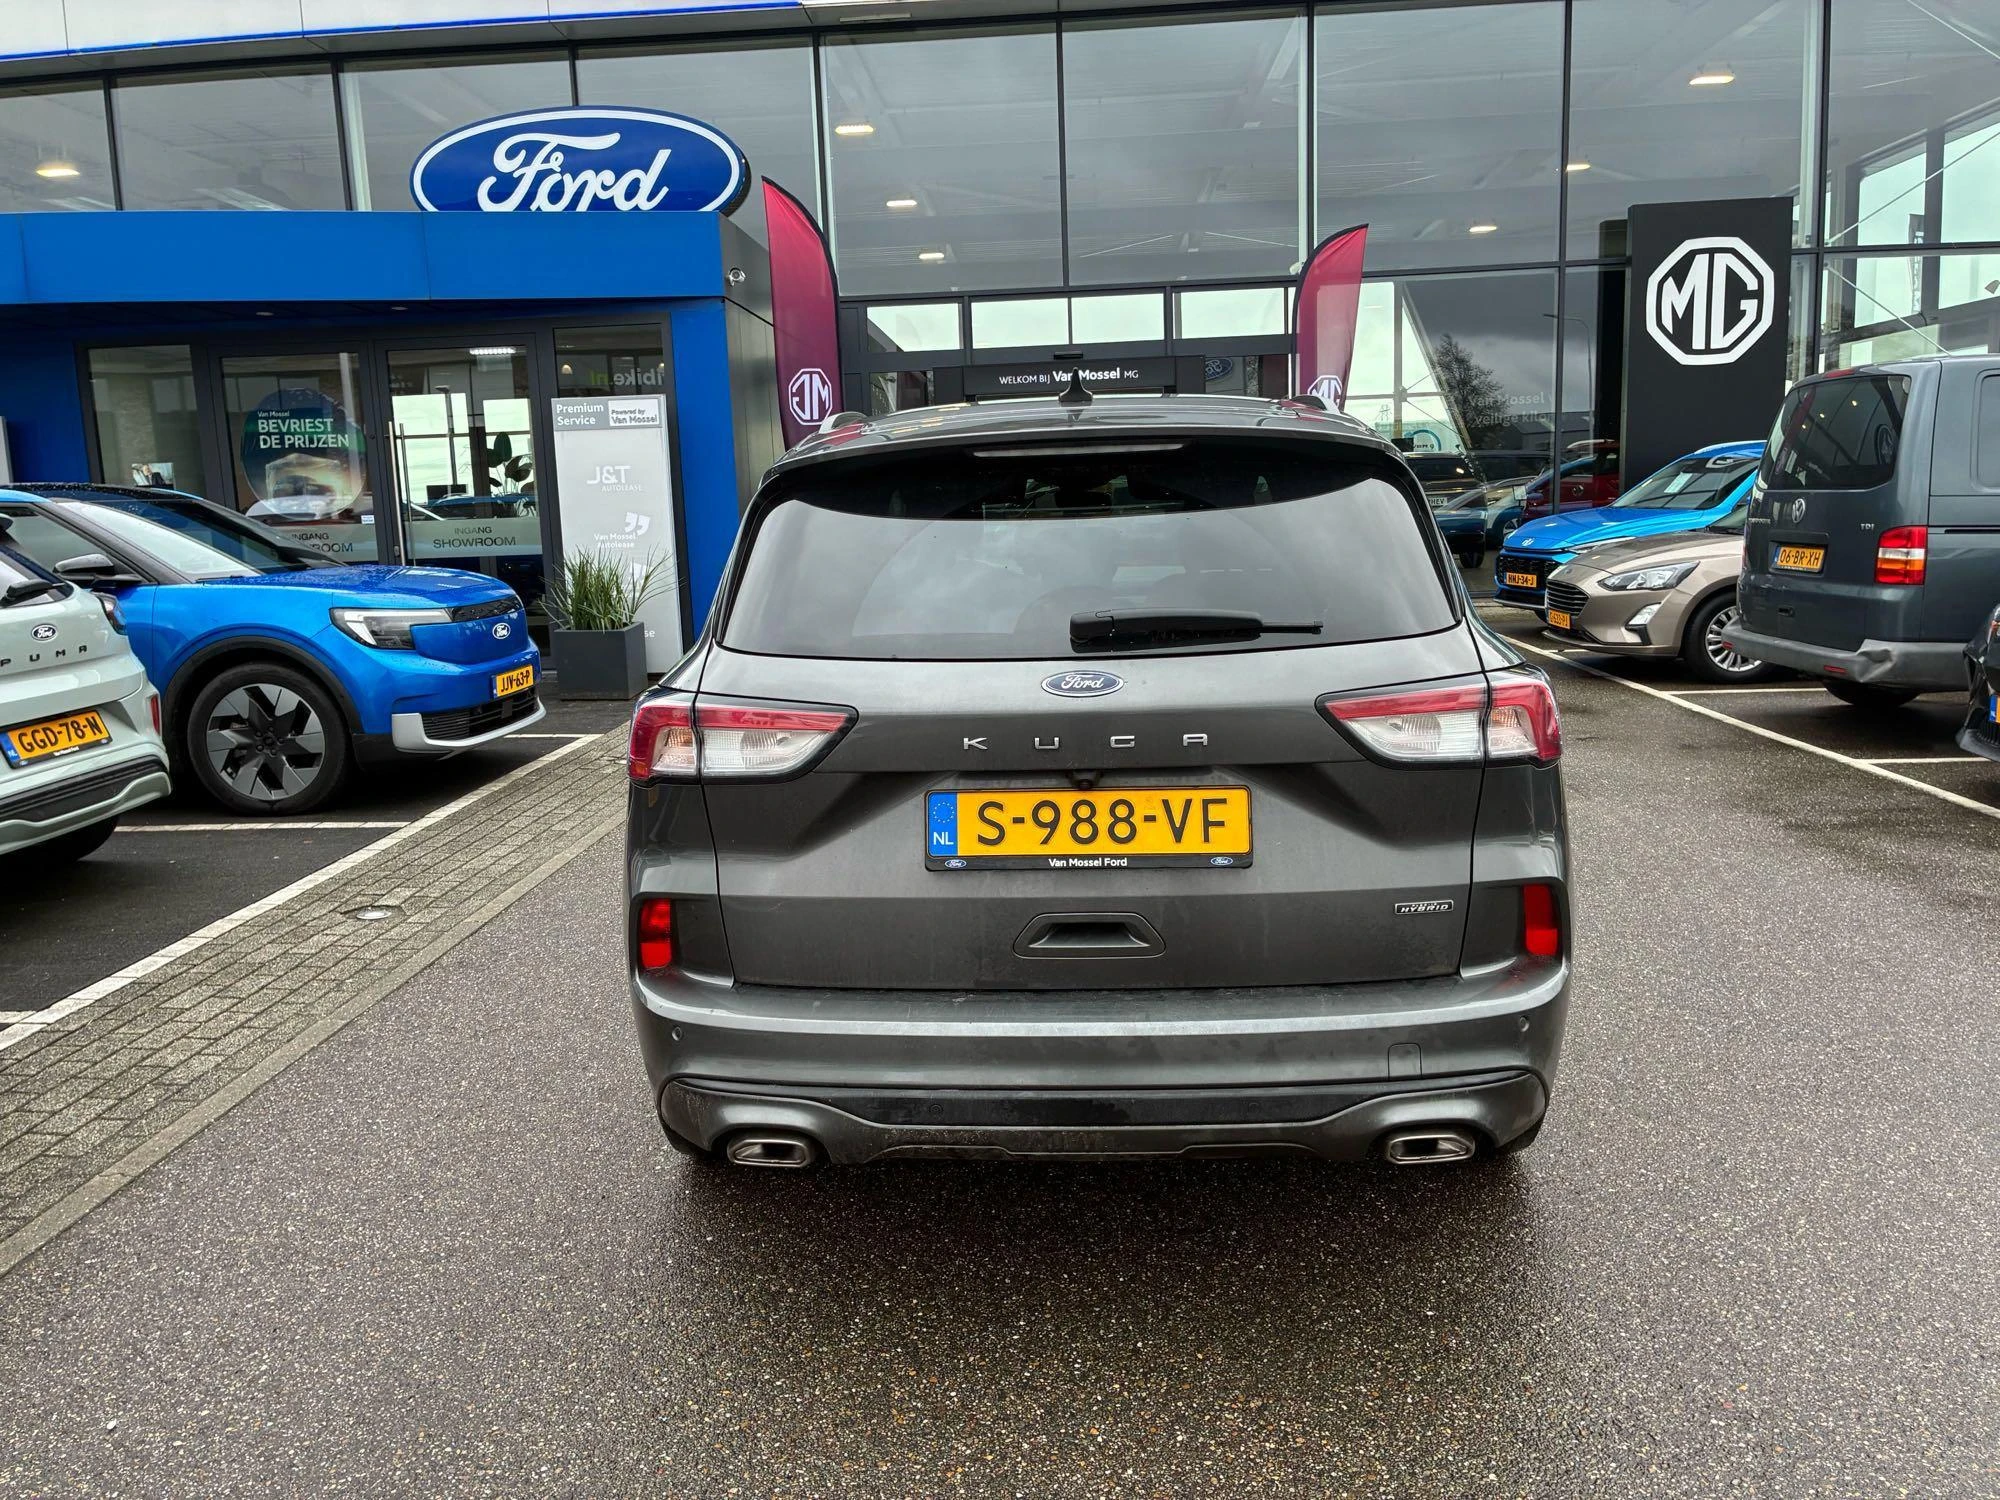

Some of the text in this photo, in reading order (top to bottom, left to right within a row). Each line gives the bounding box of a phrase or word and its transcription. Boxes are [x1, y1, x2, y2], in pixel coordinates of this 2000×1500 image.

[476, 132, 672, 212] Ford
[1660, 252, 1759, 350] MG
[999, 375, 1037, 384] WELKOM
[1039, 374, 1051, 384] BIJ
[1079, 367, 1121, 380] Mossel
[1124, 370, 1139, 379] MG
[270, 410, 290, 418] Mossel
[556, 403, 604, 414] Premium
[638, 408, 646, 416] by
[257, 418, 334, 433] BEVRIEST
[557, 416, 596, 426] Service
[611, 414, 658, 424] Van Mossel
[259, 433, 351, 449] DE PRIJZEN
[586, 465, 632, 485] J&T
[454, 526, 492, 535] INGANG
[593, 531, 636, 541] Van Mossel
[432, 535, 517, 549] SHOWROOM
[0, 644, 88, 668] PUMA
[1060, 673, 1104, 690] Ford
[17, 715, 103, 753] GGD-78-N
[962, 732, 1209, 751] KUGA
[977, 797, 1228, 846] S-988-VF
[933, 831, 954, 846] NL
[1048, 857, 1128, 867] Van Mossel Ford
[1400, 904, 1449, 913] HYBRID
